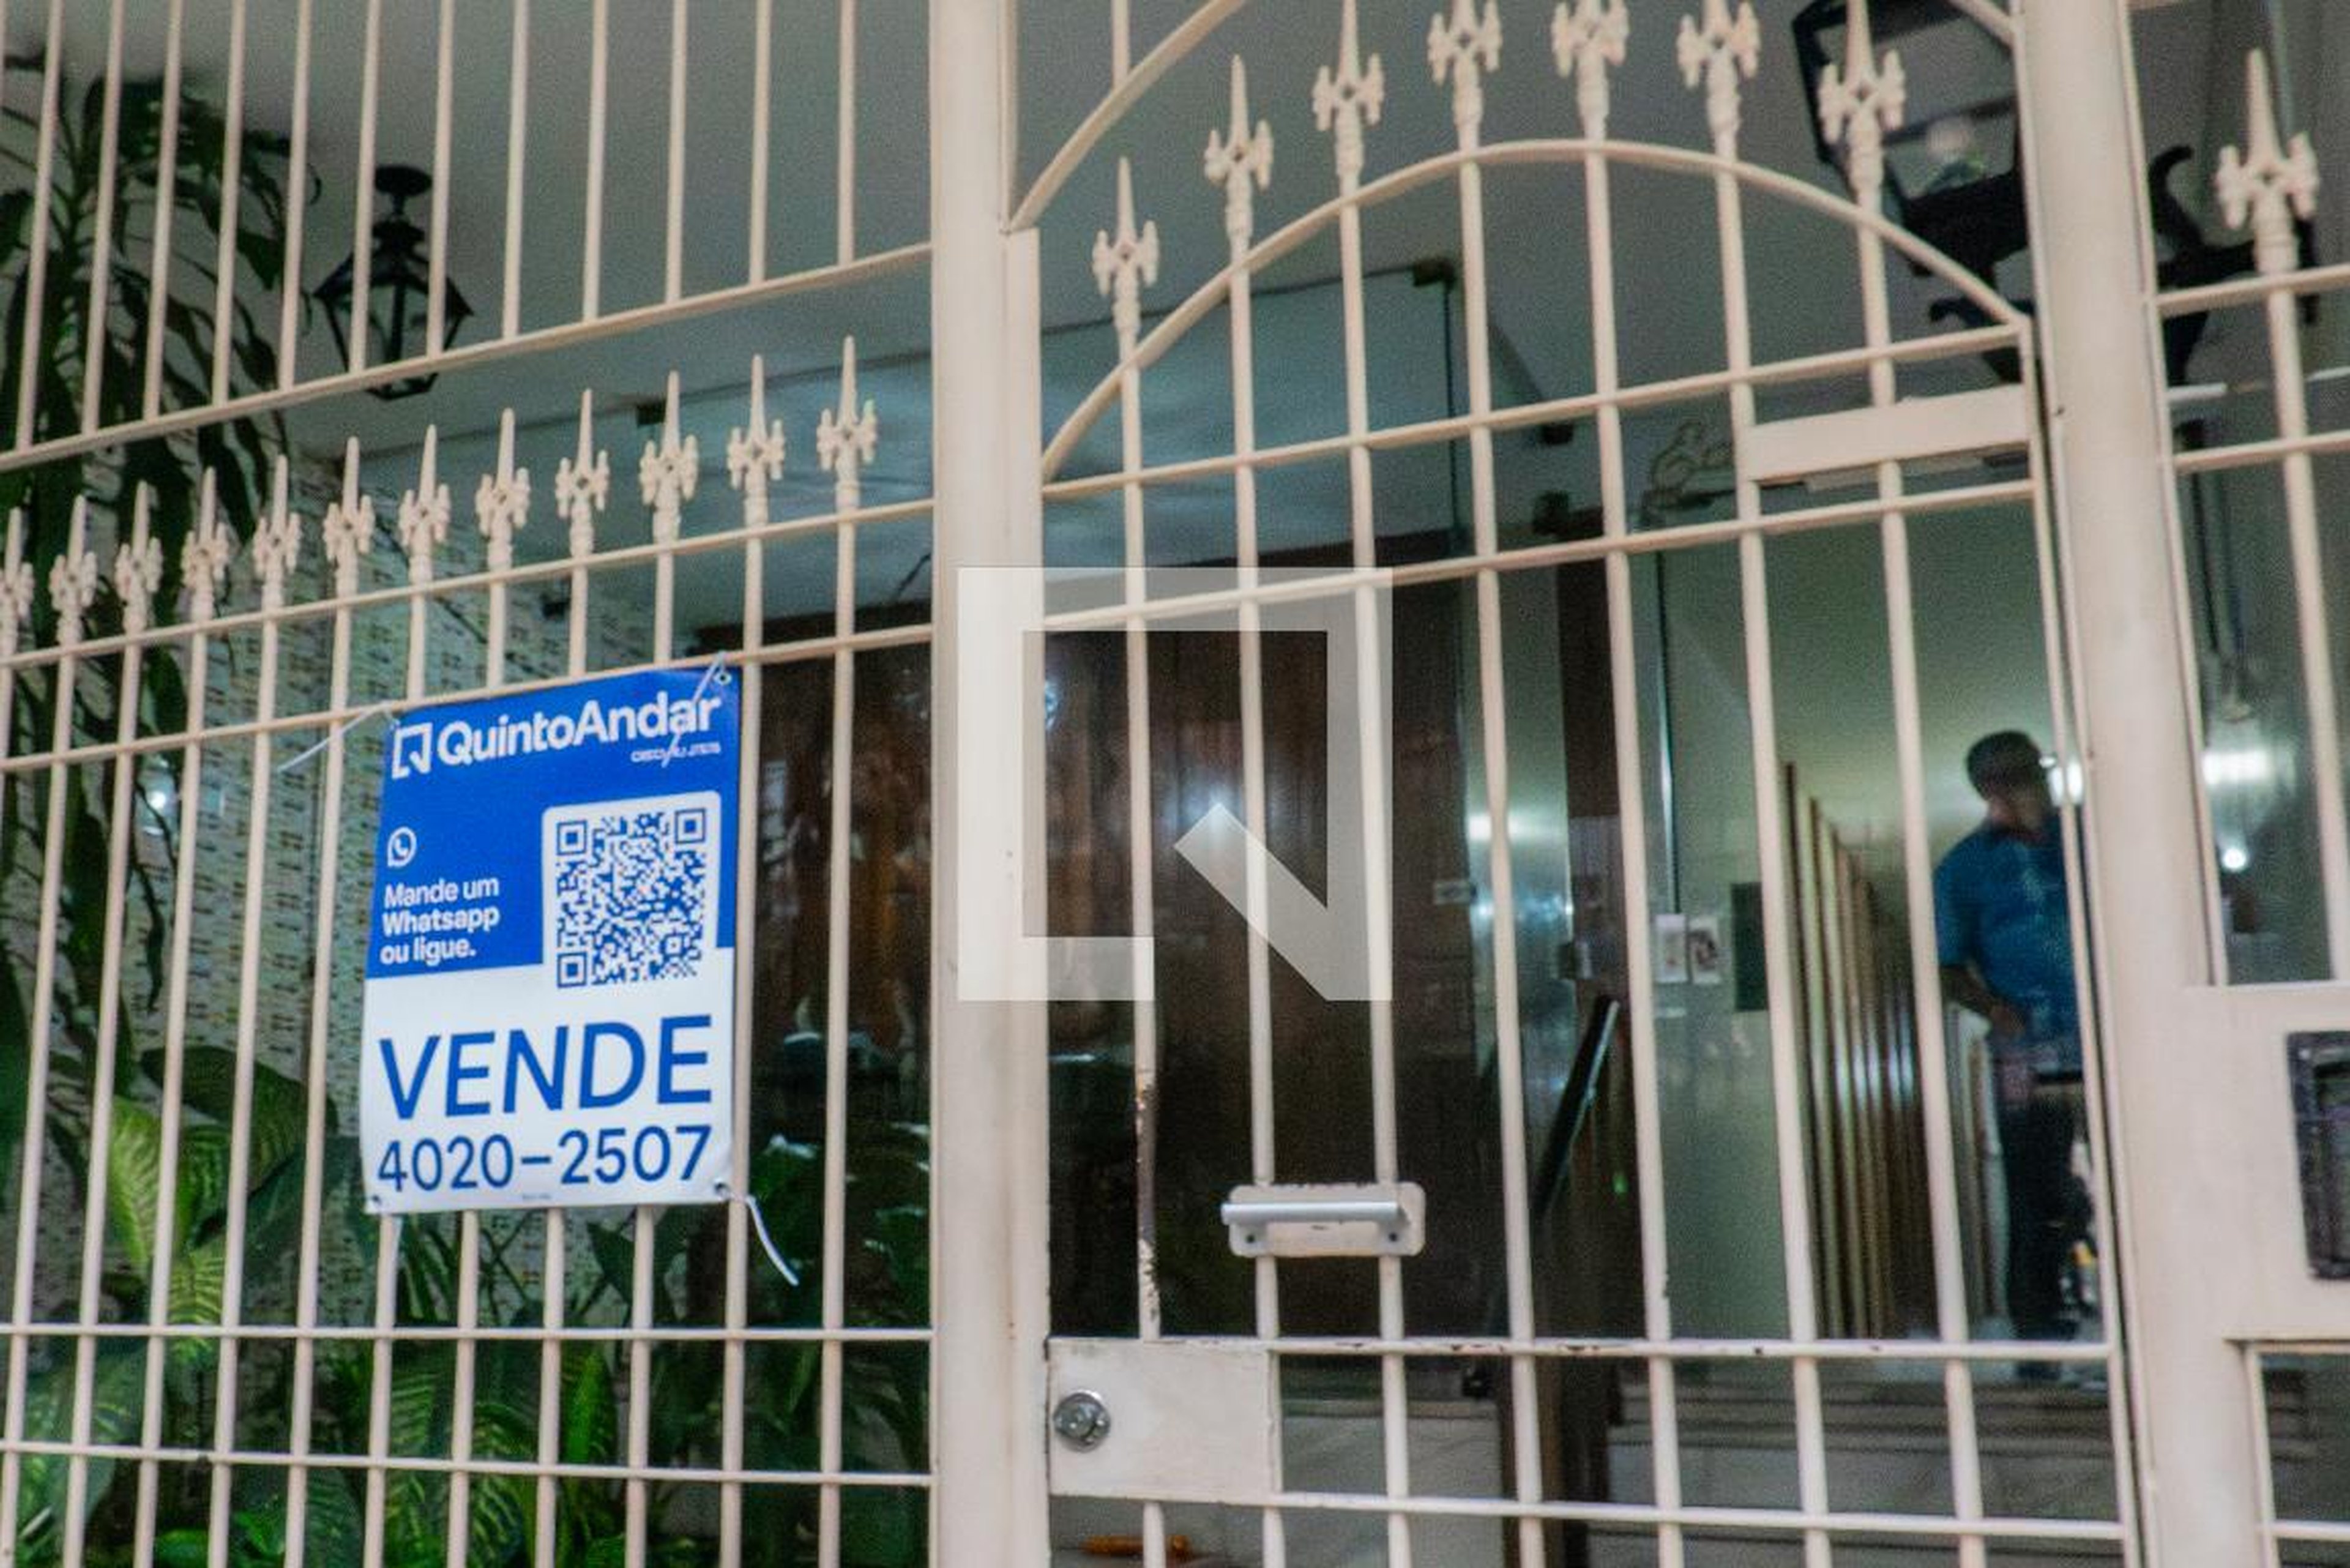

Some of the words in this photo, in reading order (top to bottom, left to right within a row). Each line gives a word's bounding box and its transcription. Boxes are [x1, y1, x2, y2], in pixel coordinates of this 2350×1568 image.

[437, 692, 722, 764] QuintoAndar
[384, 879, 458, 908] Mande
[463, 878, 499, 898] um
[382, 905, 500, 936] Whatsapp
[380, 947, 410, 965] ou
[413, 938, 477, 965] ligue.
[379, 1014, 712, 1120] VENDE
[377, 1125, 712, 1192] 4020-2507
